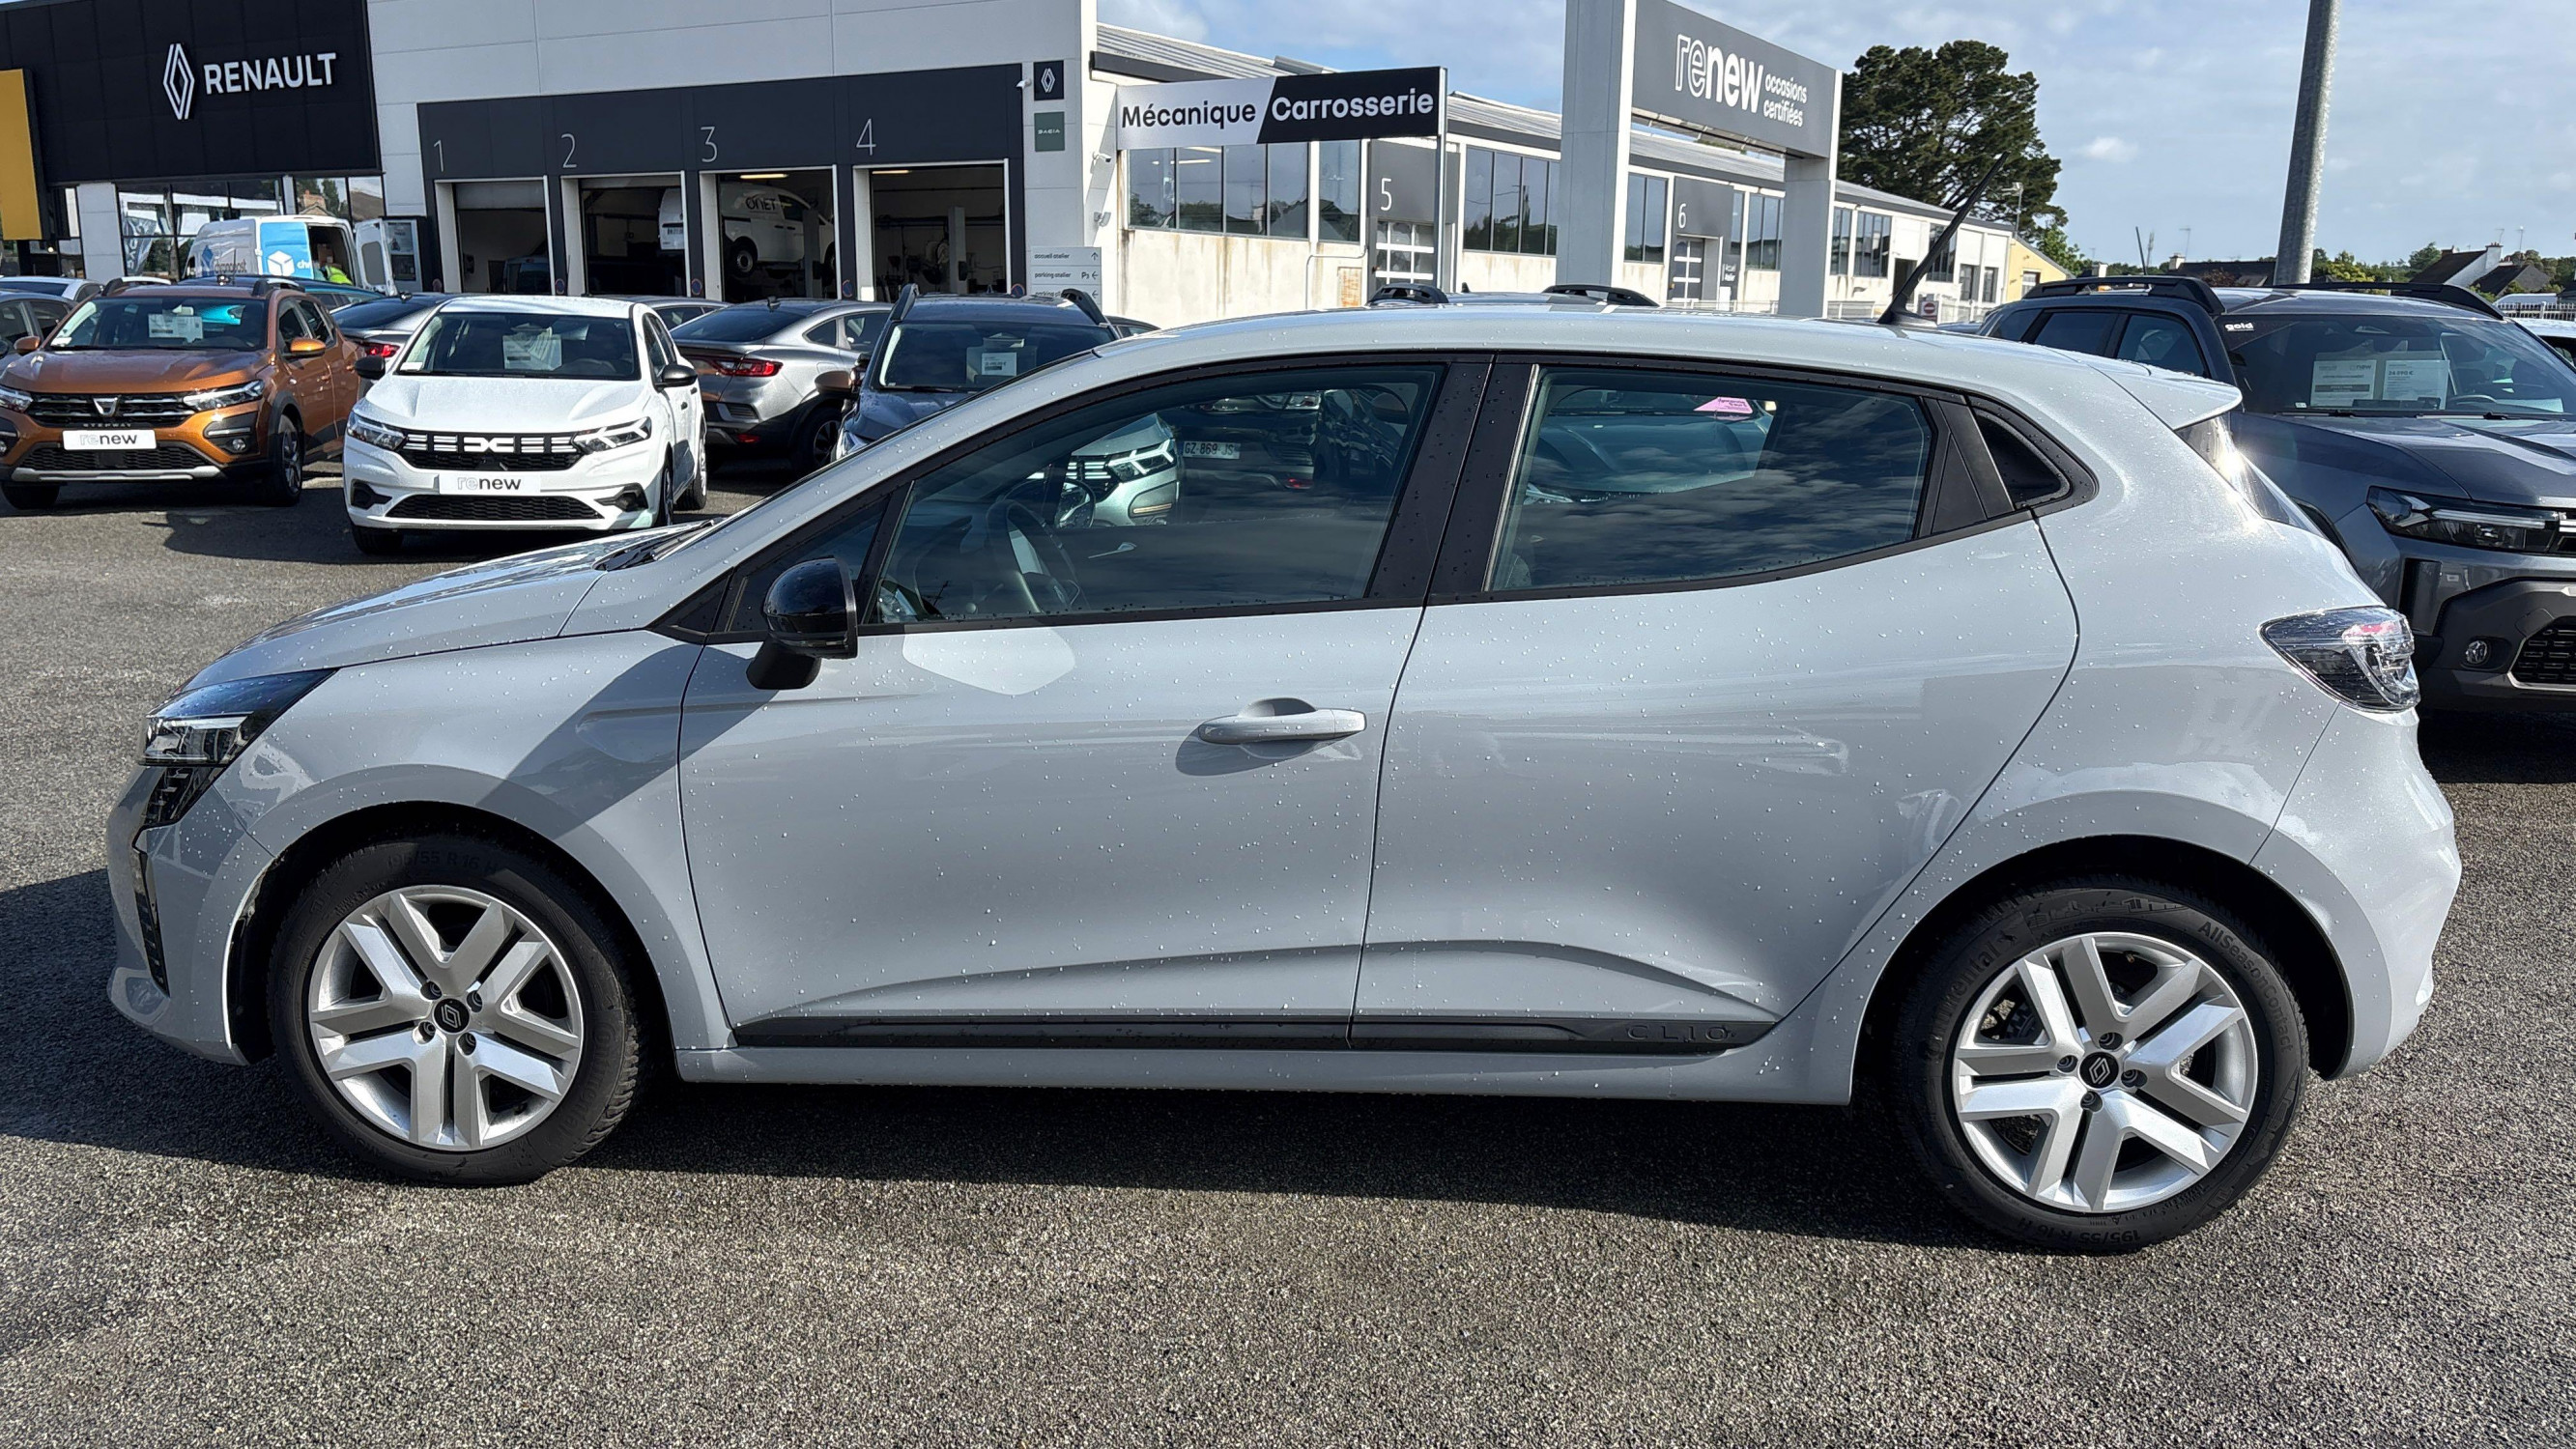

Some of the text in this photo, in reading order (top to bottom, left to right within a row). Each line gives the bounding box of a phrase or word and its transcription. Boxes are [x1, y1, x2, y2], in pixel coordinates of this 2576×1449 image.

[203, 52, 337, 95] RENAULT
[1674, 34, 1764, 114] renew
[1764, 73, 1808, 103] occasions
[1121, 88, 1434, 129] Mécanique Carrosserie
[1762, 99, 1804, 128] certifiées
[560, 133, 578, 168] 2
[701, 126, 718, 162] 3
[856, 118, 876, 156] 4
[433, 139, 444, 172] 1
[1380, 177, 1392, 211] 5
[1677, 203, 1687, 229] 6
[80, 433, 138, 446] renew
[457, 474, 523, 491] renew
[2196, 920, 2294, 1053] AllSeasonContact
[1627, 1024, 1729, 1042] CLIO
[2077, 1229, 2141, 1246] 195/55
